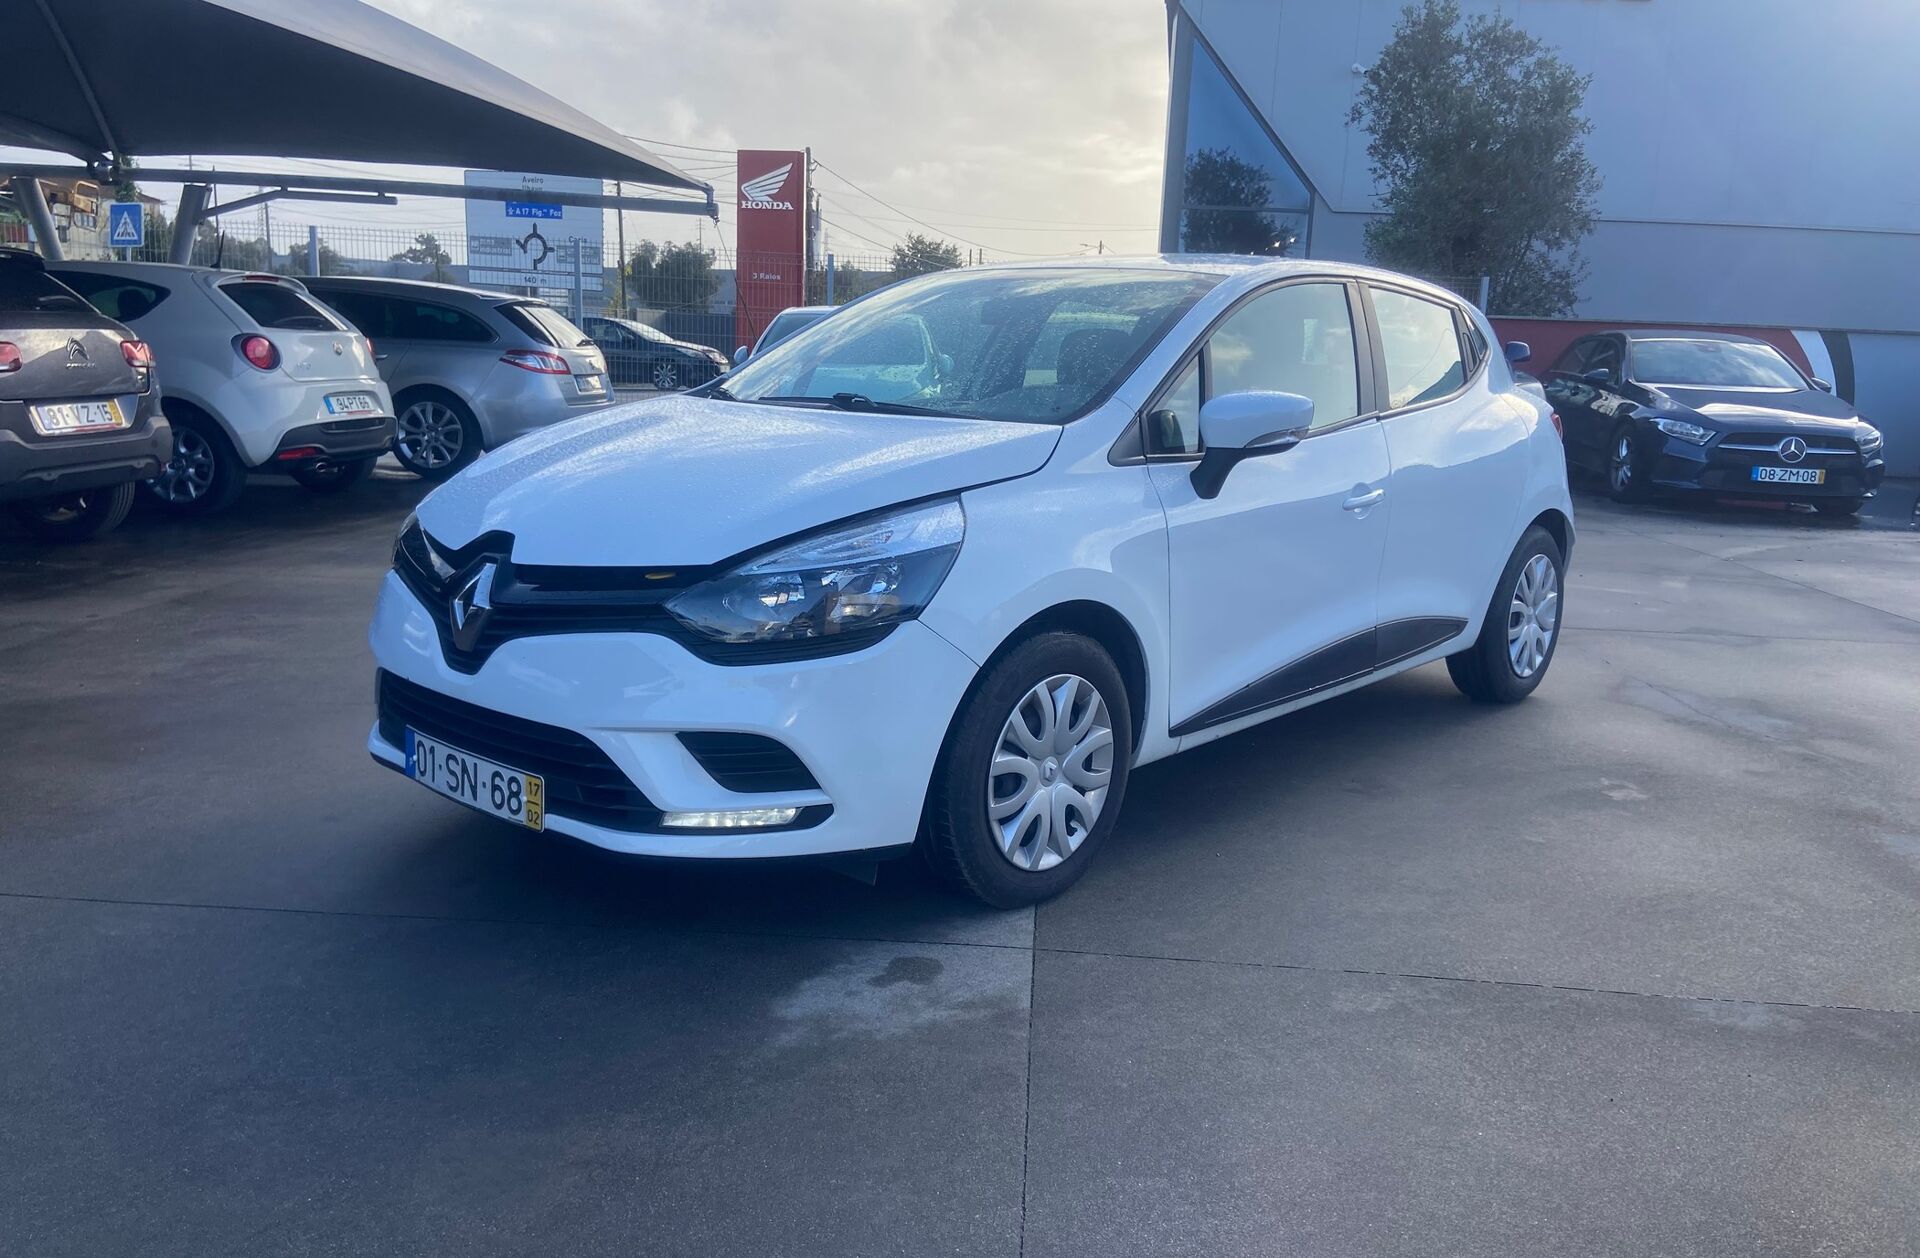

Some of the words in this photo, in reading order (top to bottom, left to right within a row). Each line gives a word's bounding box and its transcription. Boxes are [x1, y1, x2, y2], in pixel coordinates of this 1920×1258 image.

[522, 175, 544, 184] Aveiro
[741, 200, 794, 210] HONDA
[524, 276, 537, 284] 140
[752, 272, 758, 280] 3
[528, 781, 540, 797] 17
[526, 808, 540, 826] 02
